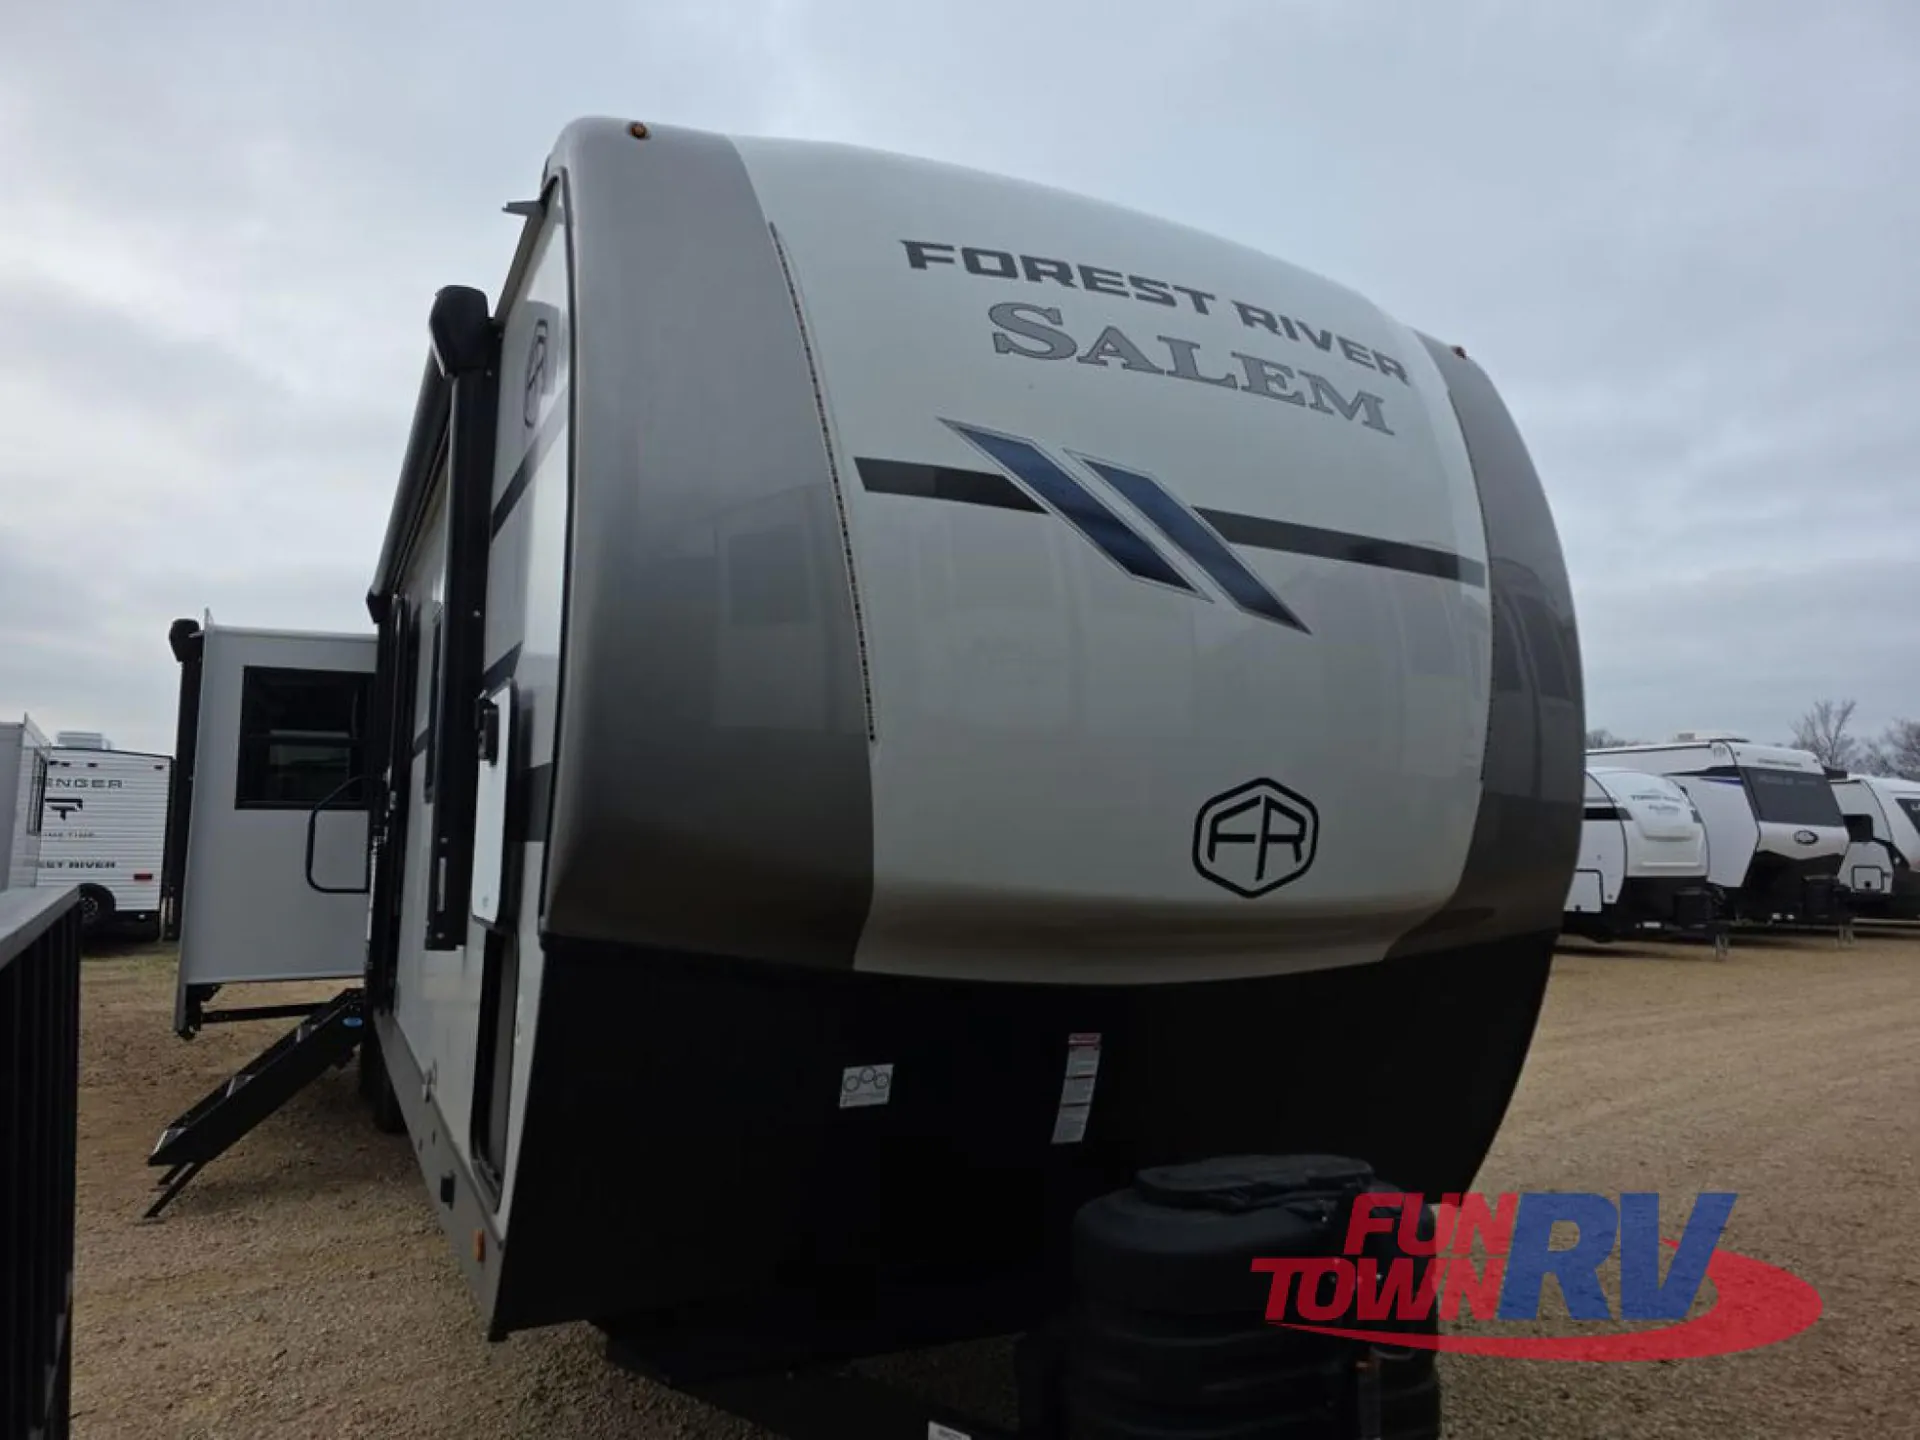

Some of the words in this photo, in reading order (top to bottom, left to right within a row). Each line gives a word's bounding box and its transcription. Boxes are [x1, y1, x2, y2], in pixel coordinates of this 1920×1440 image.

[900, 239, 1216, 315] FOREST
[1230, 300, 1410, 387] RIVER
[987, 301, 1396, 436] SALEM
